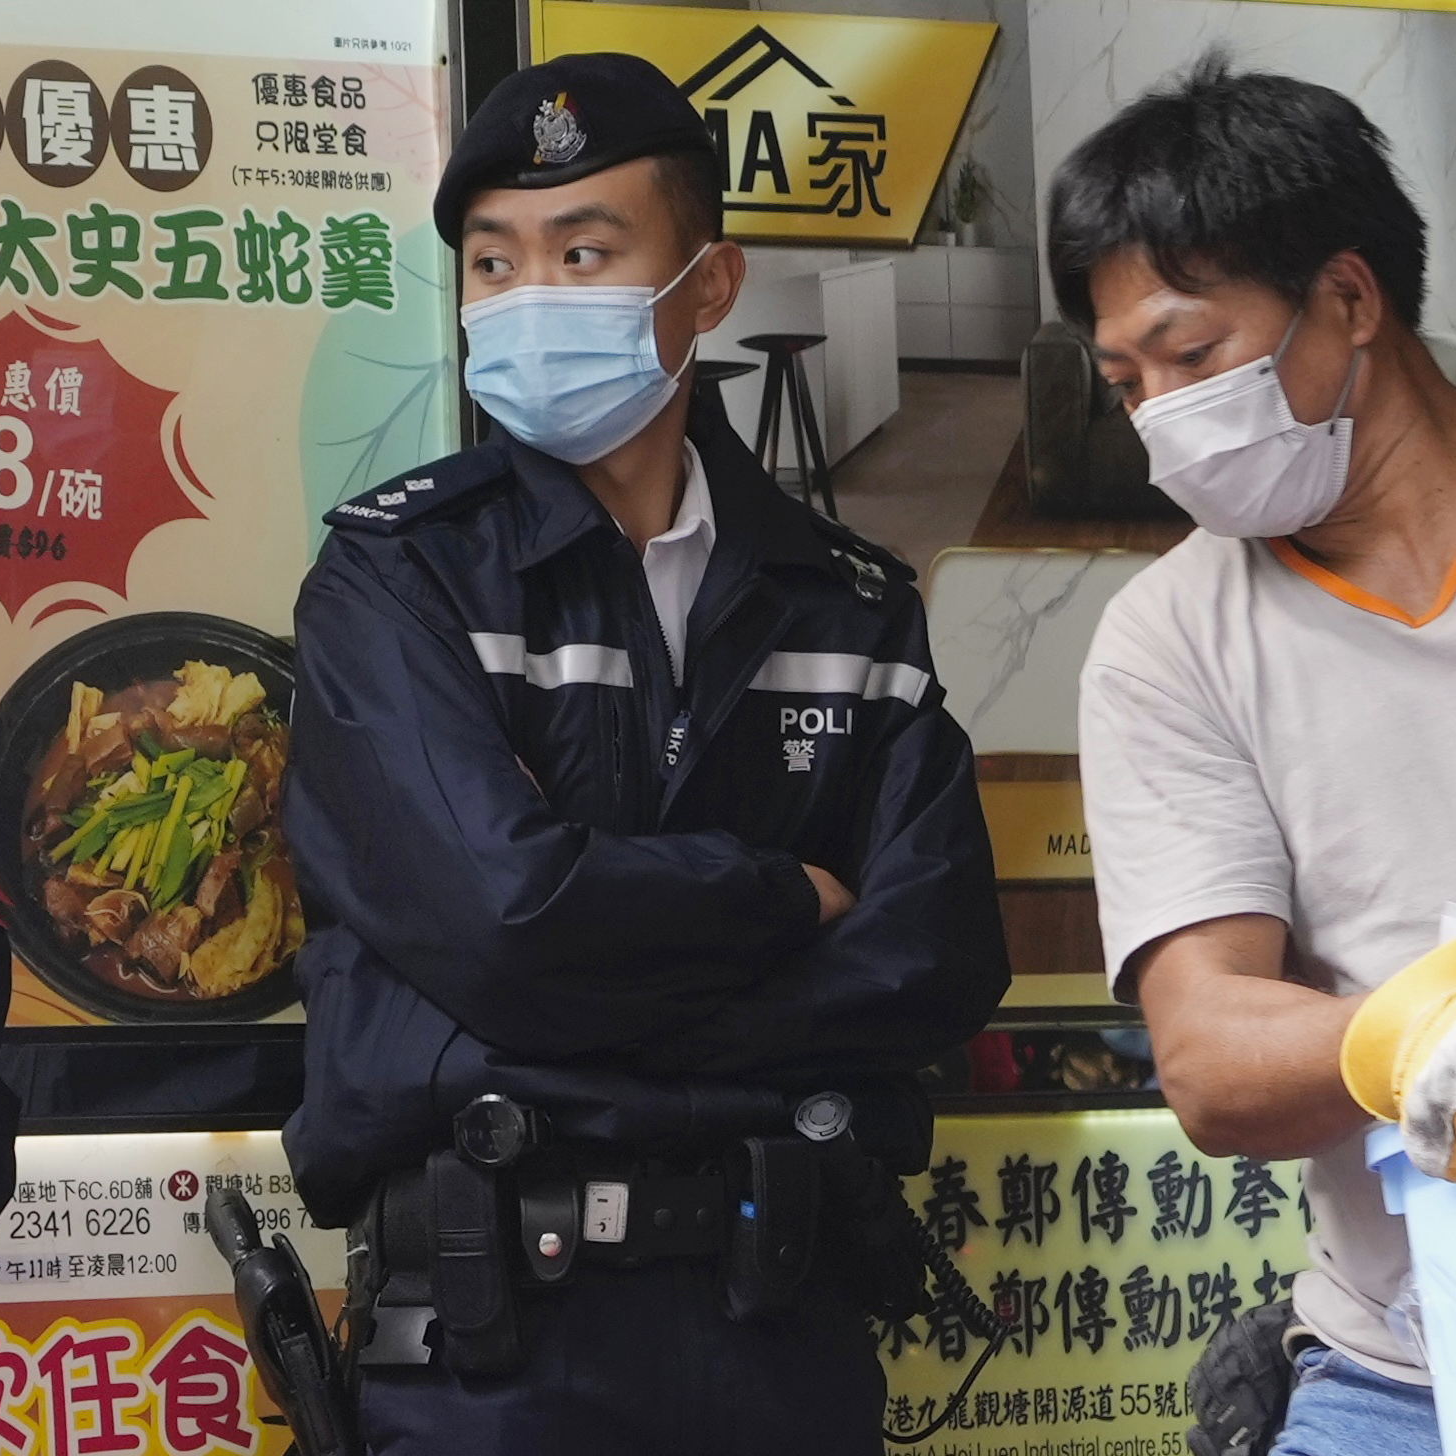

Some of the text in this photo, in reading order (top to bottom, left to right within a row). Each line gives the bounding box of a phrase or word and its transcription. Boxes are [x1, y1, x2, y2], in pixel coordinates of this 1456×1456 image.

[390, 41, 412, 51] 10/21
[252, 73, 366, 109] 優惠食品
[256, 121, 367, 157] 只限堂食
[232, 165, 391, 192] (下午5:30起開始供應)
[665, 727, 685, 766] HKP
[783, 739, 815, 772] 警
[269, 1175, 299, 1194] B3
[10, 1207, 151, 1240] 2341 6226
[183, 1210, 209, 1235] 傳
